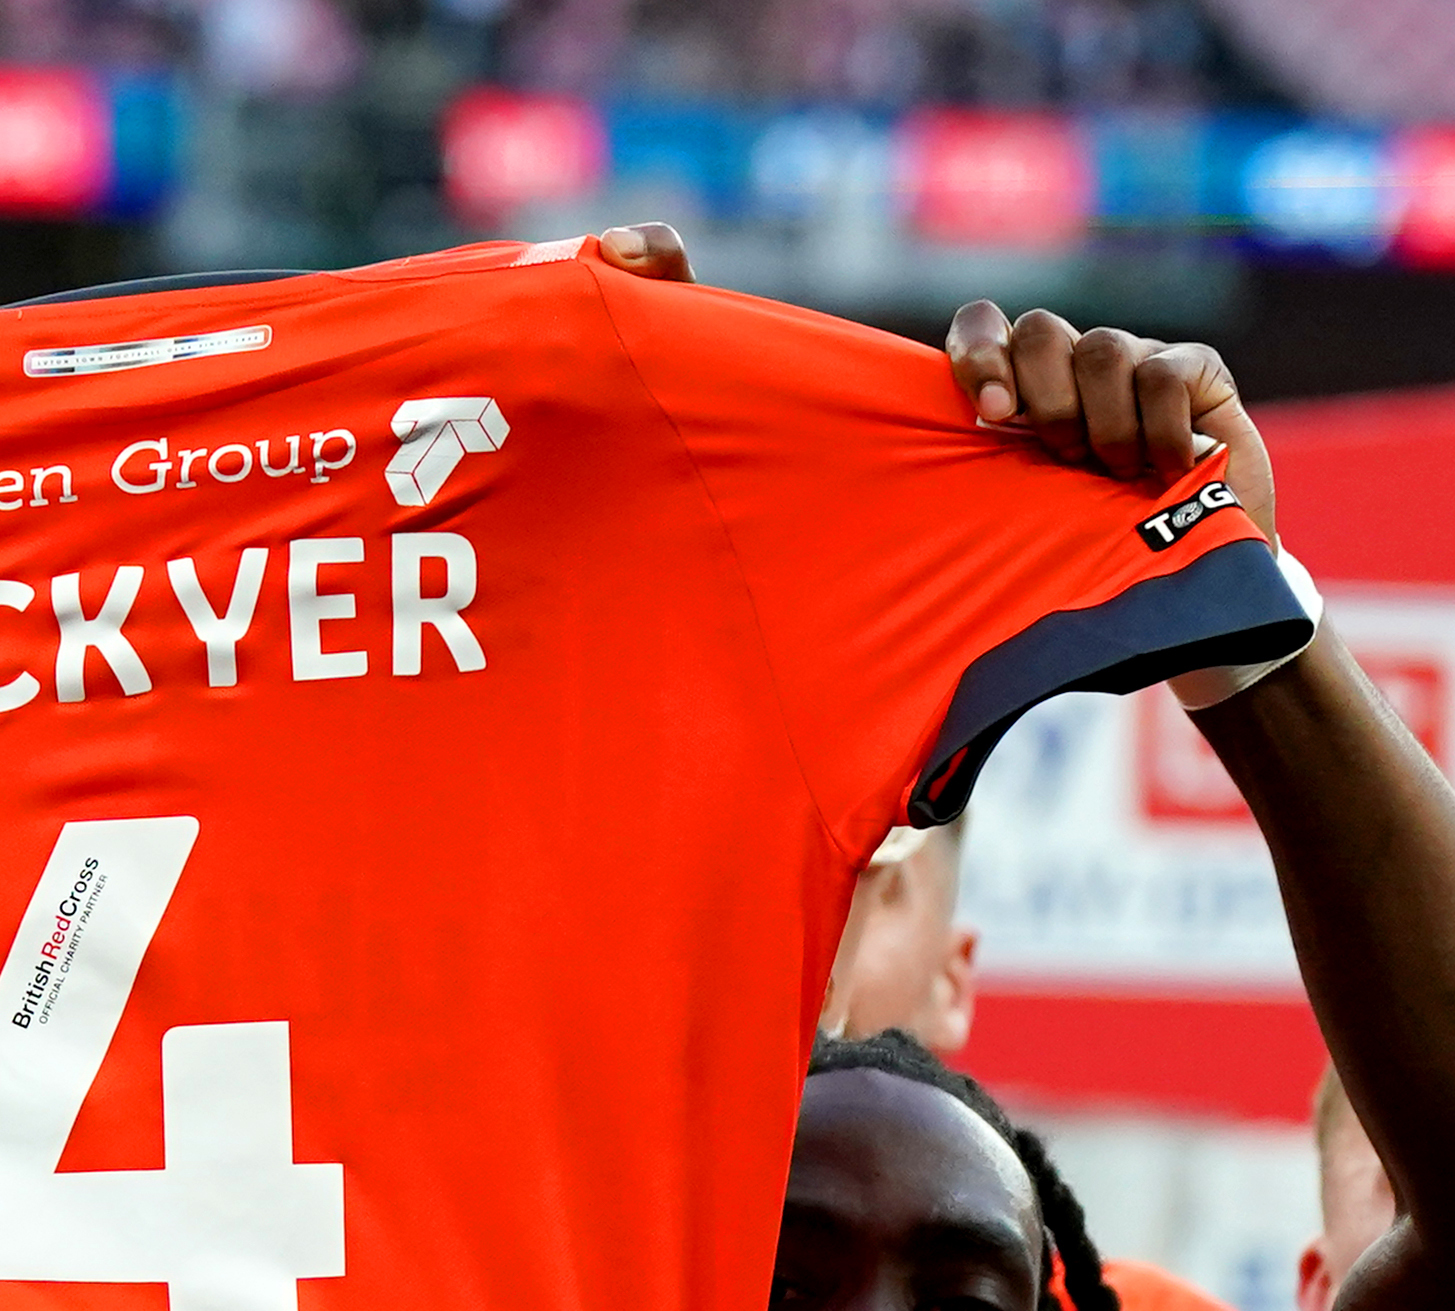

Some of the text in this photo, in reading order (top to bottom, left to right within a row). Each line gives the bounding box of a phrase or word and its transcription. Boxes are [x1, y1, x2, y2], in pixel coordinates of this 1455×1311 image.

[109, 426, 356, 495] Group
[1144, 482, 1242, 543] TOG
[38, 873, 108, 1026] OFFICIAL CHARITY PARTNER
